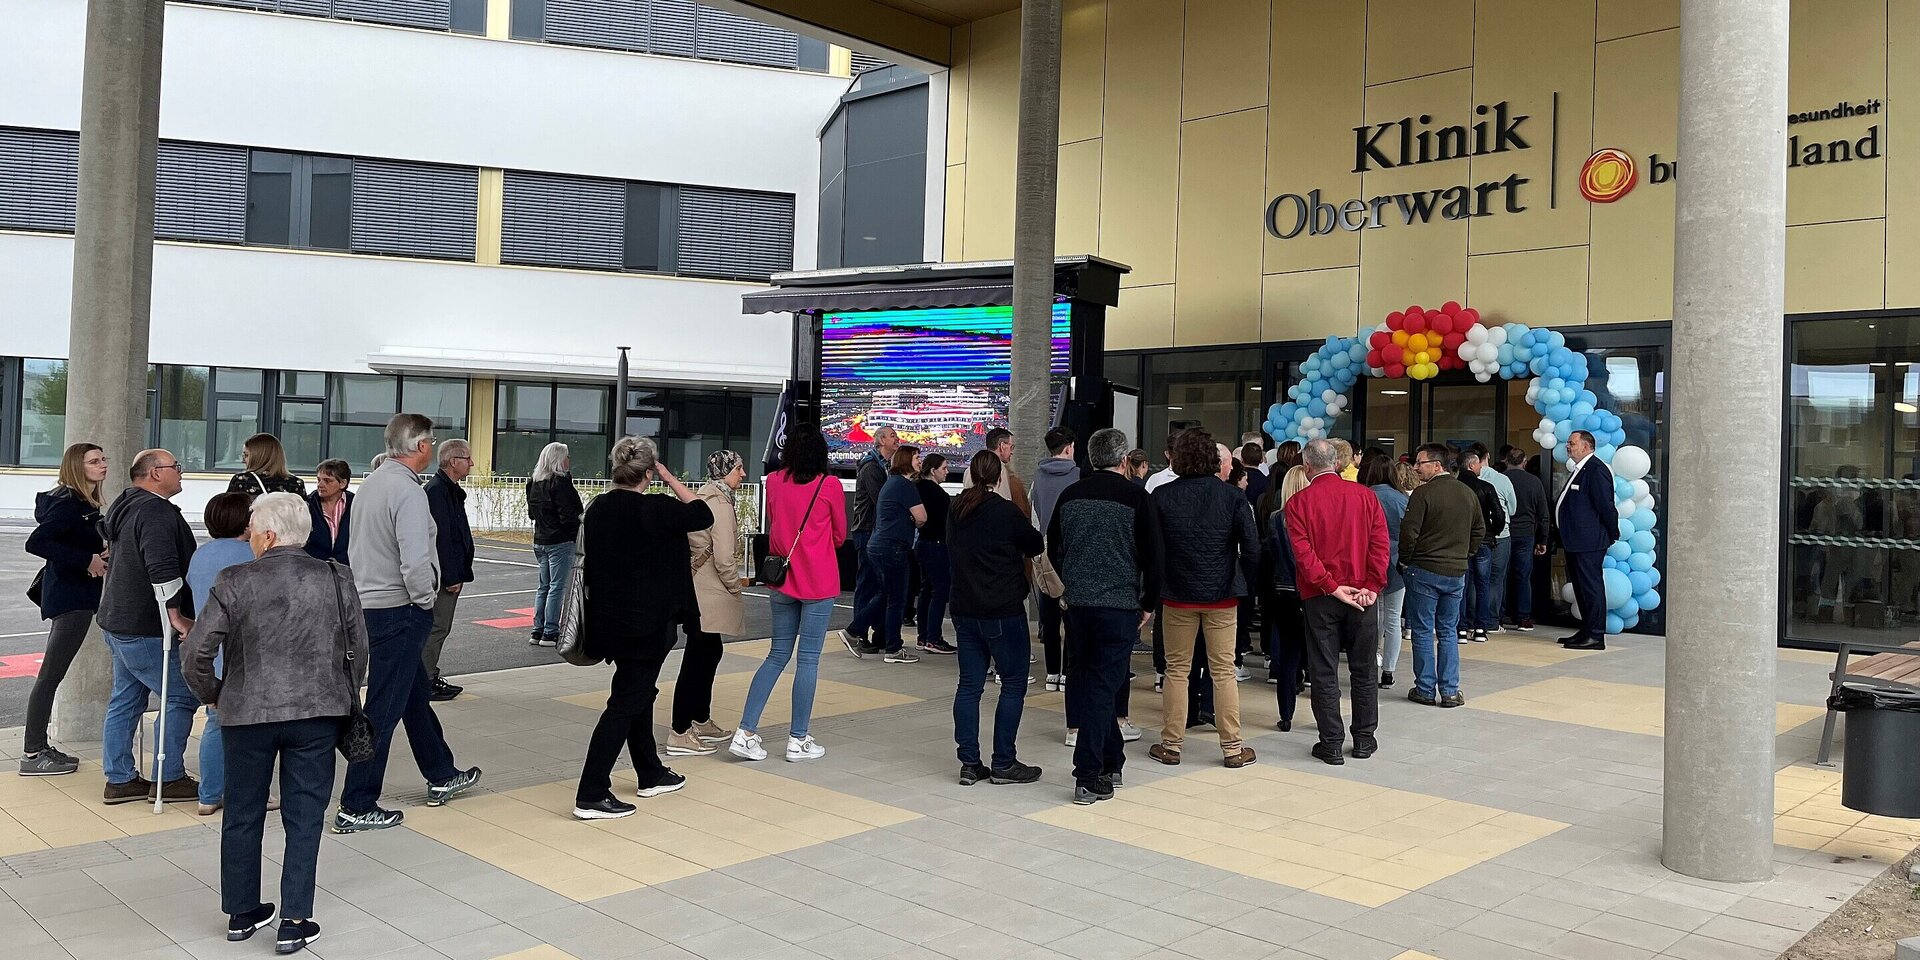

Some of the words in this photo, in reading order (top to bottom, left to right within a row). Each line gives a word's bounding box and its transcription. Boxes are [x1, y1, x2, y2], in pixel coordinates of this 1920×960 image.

[1788, 98, 1881, 126] esundheit
[1351, 100, 1532, 174] Klinik
[1265, 173, 1531, 240] Oberwart
[827, 450, 862, 461] eptember
